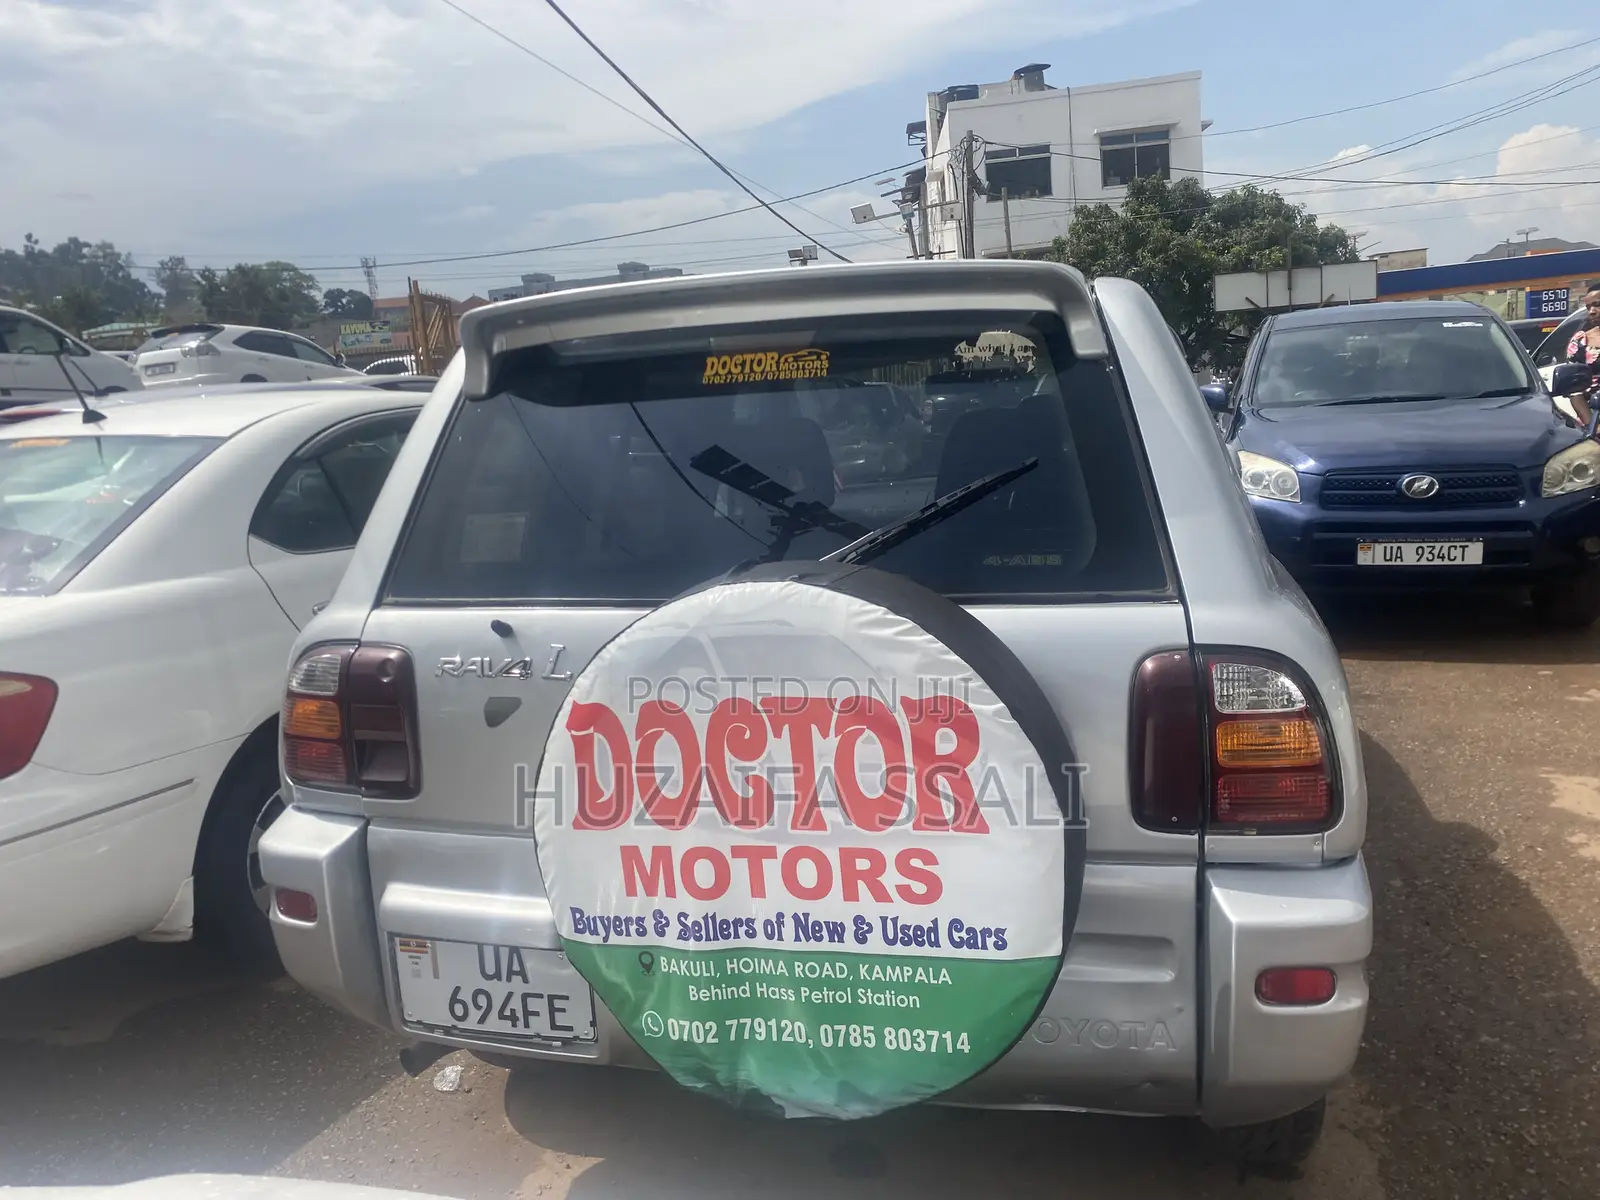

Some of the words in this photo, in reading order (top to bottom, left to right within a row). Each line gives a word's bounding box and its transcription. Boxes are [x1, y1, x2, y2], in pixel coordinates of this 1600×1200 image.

[1542, 289, 1567, 301] 6570
[1542, 301, 1567, 312] 6690
[704, 352, 779, 376] DOCTOR
[779, 360, 829, 371] MOTORS
[1383, 545, 1404, 563] UA
[1415, 545, 1469, 563] 934CT
[434, 655, 533, 681] RAV4
[541, 643, 573, 681] L
[565, 694, 992, 836] DOCTOR
[619, 845, 944, 906] MOTORS
[570, 907, 648, 943] Buyers
[652, 909, 670, 938] &
[676, 911, 758, 942] Sellers
[763, 911, 785, 942] of
[791, 912, 846, 943] New
[852, 914, 874, 945] &
[879, 915, 942, 948] Used
[947, 918, 1008, 951] Cars
[477, 943, 530, 984] UA
[660, 956, 720, 979] BAKULI,
[726, 957, 789, 978] HOIMA
[794, 962, 853, 982] ROAD,
[859, 964, 953, 986] KAMPALA
[448, 985, 574, 1032] 694FE
[688, 981, 751, 1002] Behind
[756, 983, 795, 1002] Hass
[801, 986, 852, 1005] Petrol
[857, 987, 921, 1009] Station
[667, 1017, 719, 1044] 0702
[725, 1018, 814, 1050] 779120,
[819, 1024, 876, 1050] 0785
[883, 1027, 971, 1054] 803714
[1018, 1017, 1178, 1051] OYOTA
